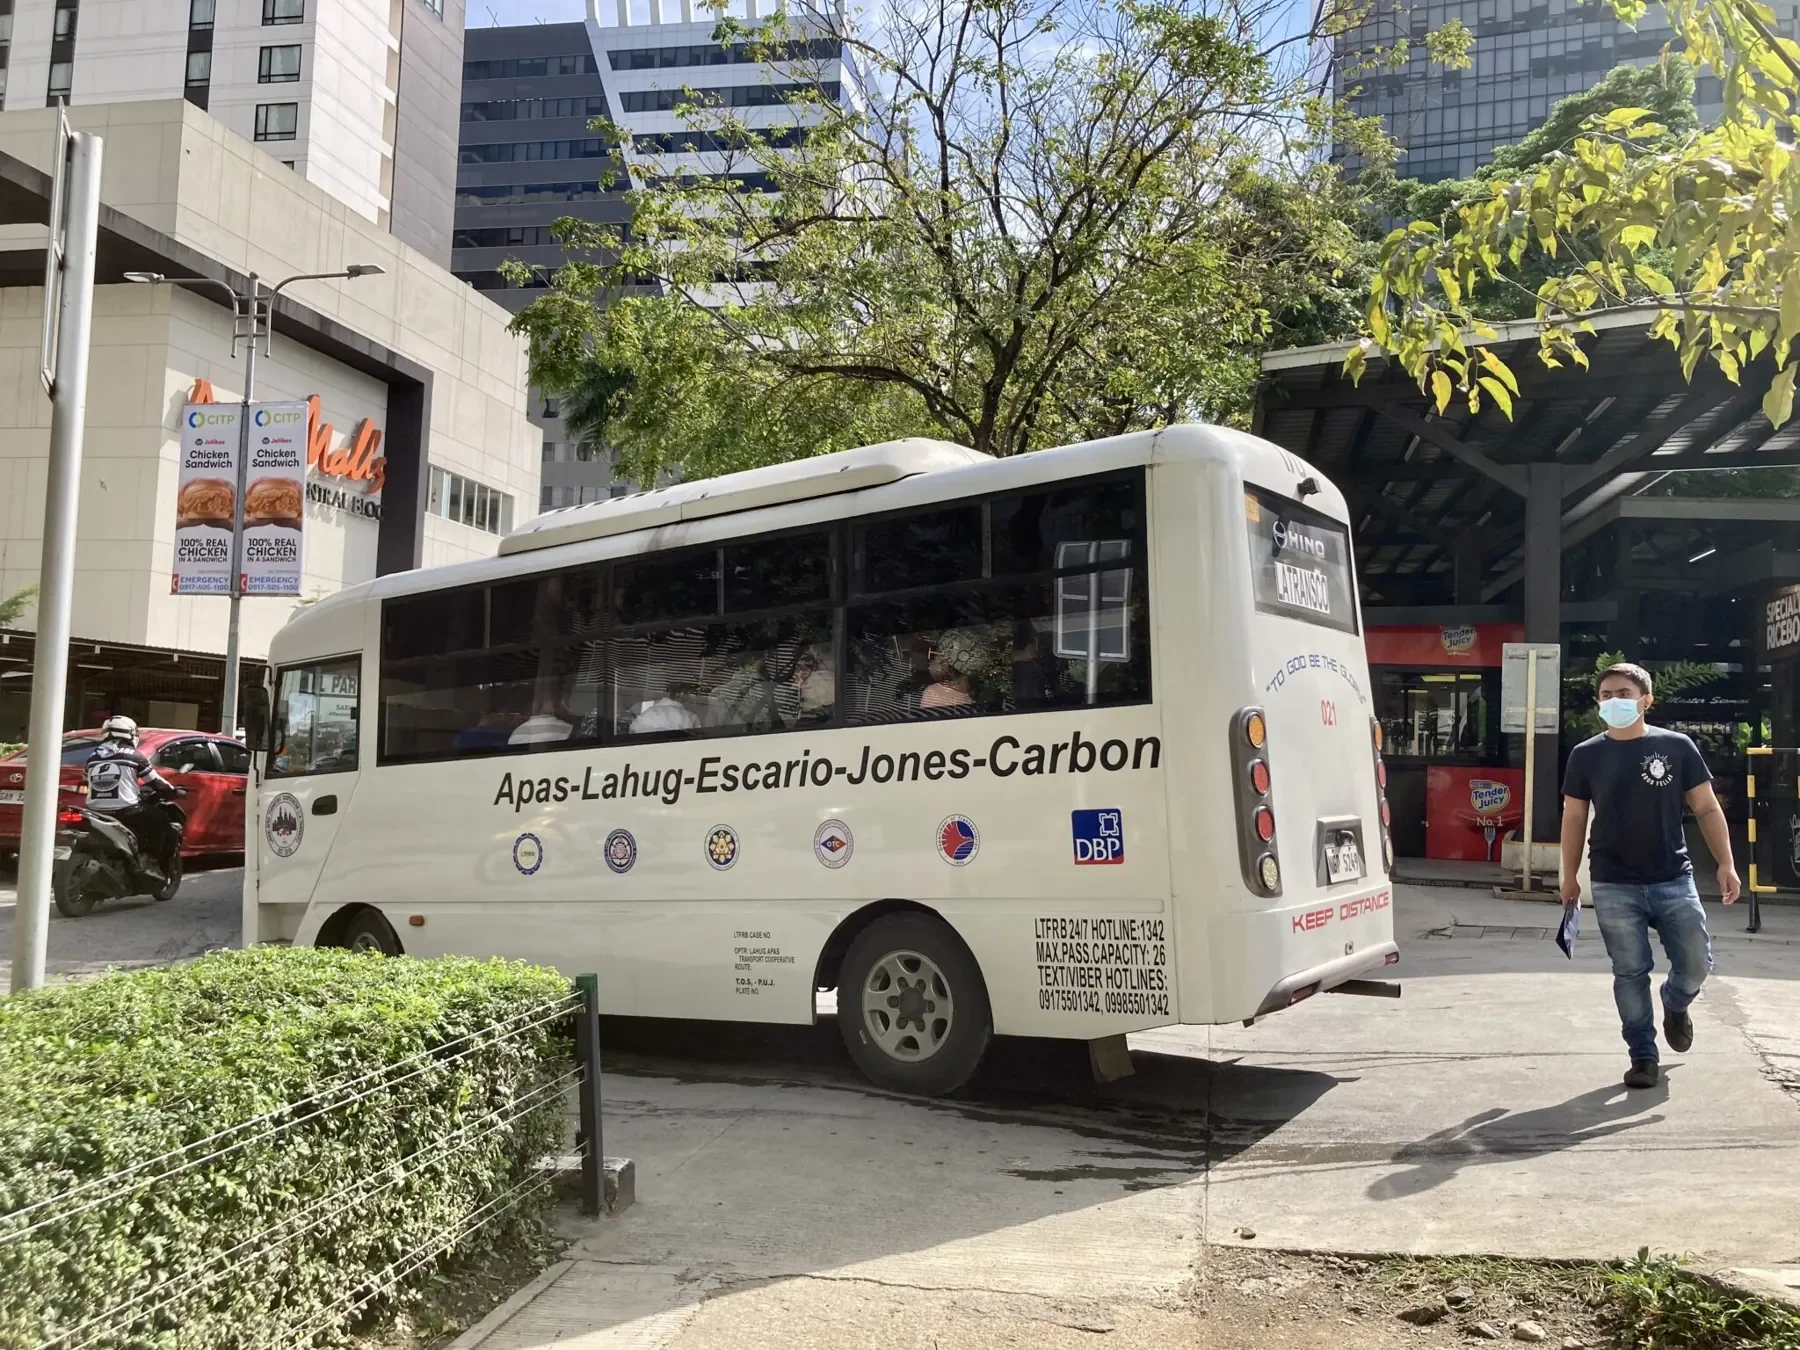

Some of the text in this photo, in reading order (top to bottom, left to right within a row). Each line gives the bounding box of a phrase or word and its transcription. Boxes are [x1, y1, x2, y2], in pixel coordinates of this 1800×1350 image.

[207, 414, 235, 425] CITP
[273, 412, 301, 423] CITP
[190, 450, 229, 459] Chicken
[257, 449, 296, 458] Chicken
[185, 459, 233, 469] Sandwich
[252, 458, 300, 468] Sandwich
[180, 538, 228, 547] 100% REAL
[248, 538, 297, 547] 100% REAL
[1288, 530, 1325, 556] HINO
[178, 547, 228, 557] CHICKEN
[246, 547, 297, 557] CHICKEN
[1443, 628, 1474, 640] Tender
[1766, 615, 1800, 650] RICEBO
[1447, 636, 1471, 648] Juicy
[1287, 655, 1306, 675] GOD
[1309, 654, 1321, 668] BE
[1321, 655, 1338, 672] THE
[331, 675, 357, 694] PAR
[1321, 699, 1337, 726] 021
[494, 731, 1161, 812] Apas-Lahug-Escario-Jones-Carbon
[1473, 787, 1508, 800] Tender
[1478, 796, 1504, 809] Juicy
[1076, 837, 1120, 861] DBP
[1292, 891, 1389, 934] KEEP DISTANCE
[733, 931, 748, 939] LTFRB
[749, 931, 762, 939] CASE
[1035, 918, 1067, 939] LTFRB
[1069, 919, 1088, 940] 24/7
[767, 947, 780, 955] APAS
[1153, 944, 1166, 966] 26
[739, 955, 795, 964] TRANSPORT COOPERATIVE
[1037, 965, 1168, 991] TEXT/VIBER HOTLINES:
[735, 987, 750, 995] PLATE
[1105, 991, 1169, 1016] 09985501342
